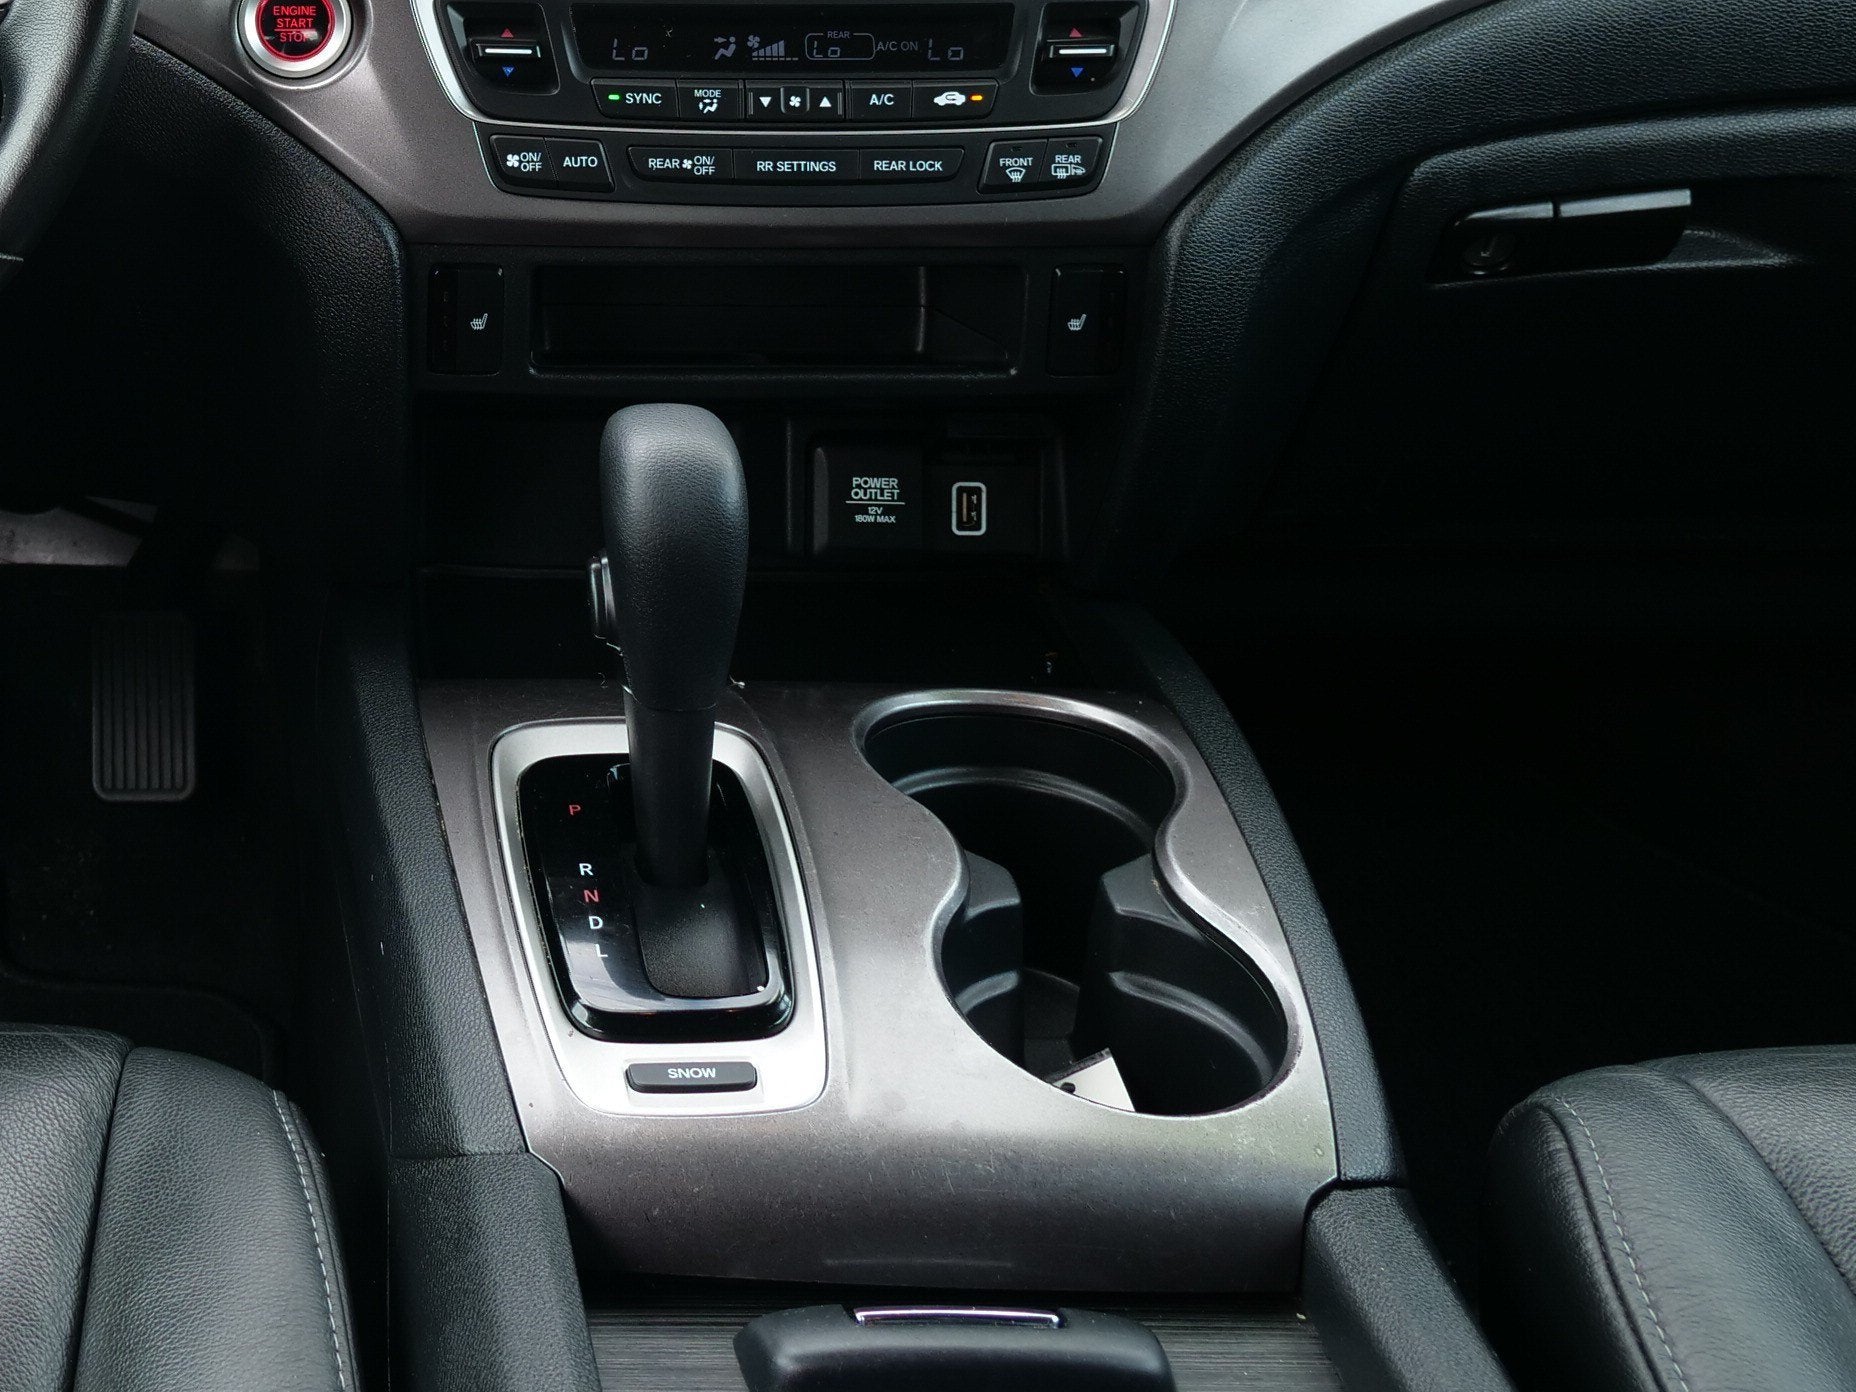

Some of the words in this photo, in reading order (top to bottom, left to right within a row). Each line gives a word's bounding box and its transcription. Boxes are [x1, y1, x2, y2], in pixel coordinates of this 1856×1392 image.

[273, 6, 317, 16] ENGINE
[276, 18, 314, 28] START
[827, 30, 850, 39] REAR
[876, 40, 899, 51] A/C
[900, 41, 919, 51] ON
[625, 93, 662, 104] SYNC
[694, 89, 722, 98] MODE
[869, 94, 894, 106] A/C
[563, 157, 598, 168] AUTO
[648, 158, 680, 169] REAR
[999, 157, 1034, 167] FRONT
[1055, 154, 1082, 164] REAR
[520, 162, 543, 172] OFF
[693, 165, 716, 175] OFF
[756, 160, 774, 172] RR
[776, 160, 837, 172] SETTINGS
[873, 160, 907, 172] REAR
[909, 160, 943, 172] LOCK
[852, 477, 899, 488] POWER
[851, 489, 900, 500] OUTLET
[868, 506, 883, 514] 12V
[876, 515, 896, 523] MAX
[568, 804, 582, 816] P
[578, 863, 594, 876] R
[583, 889, 600, 903] N
[588, 915, 604, 930] D
[595, 943, 609, 958] L
[667, 1067, 717, 1078] SNOW
